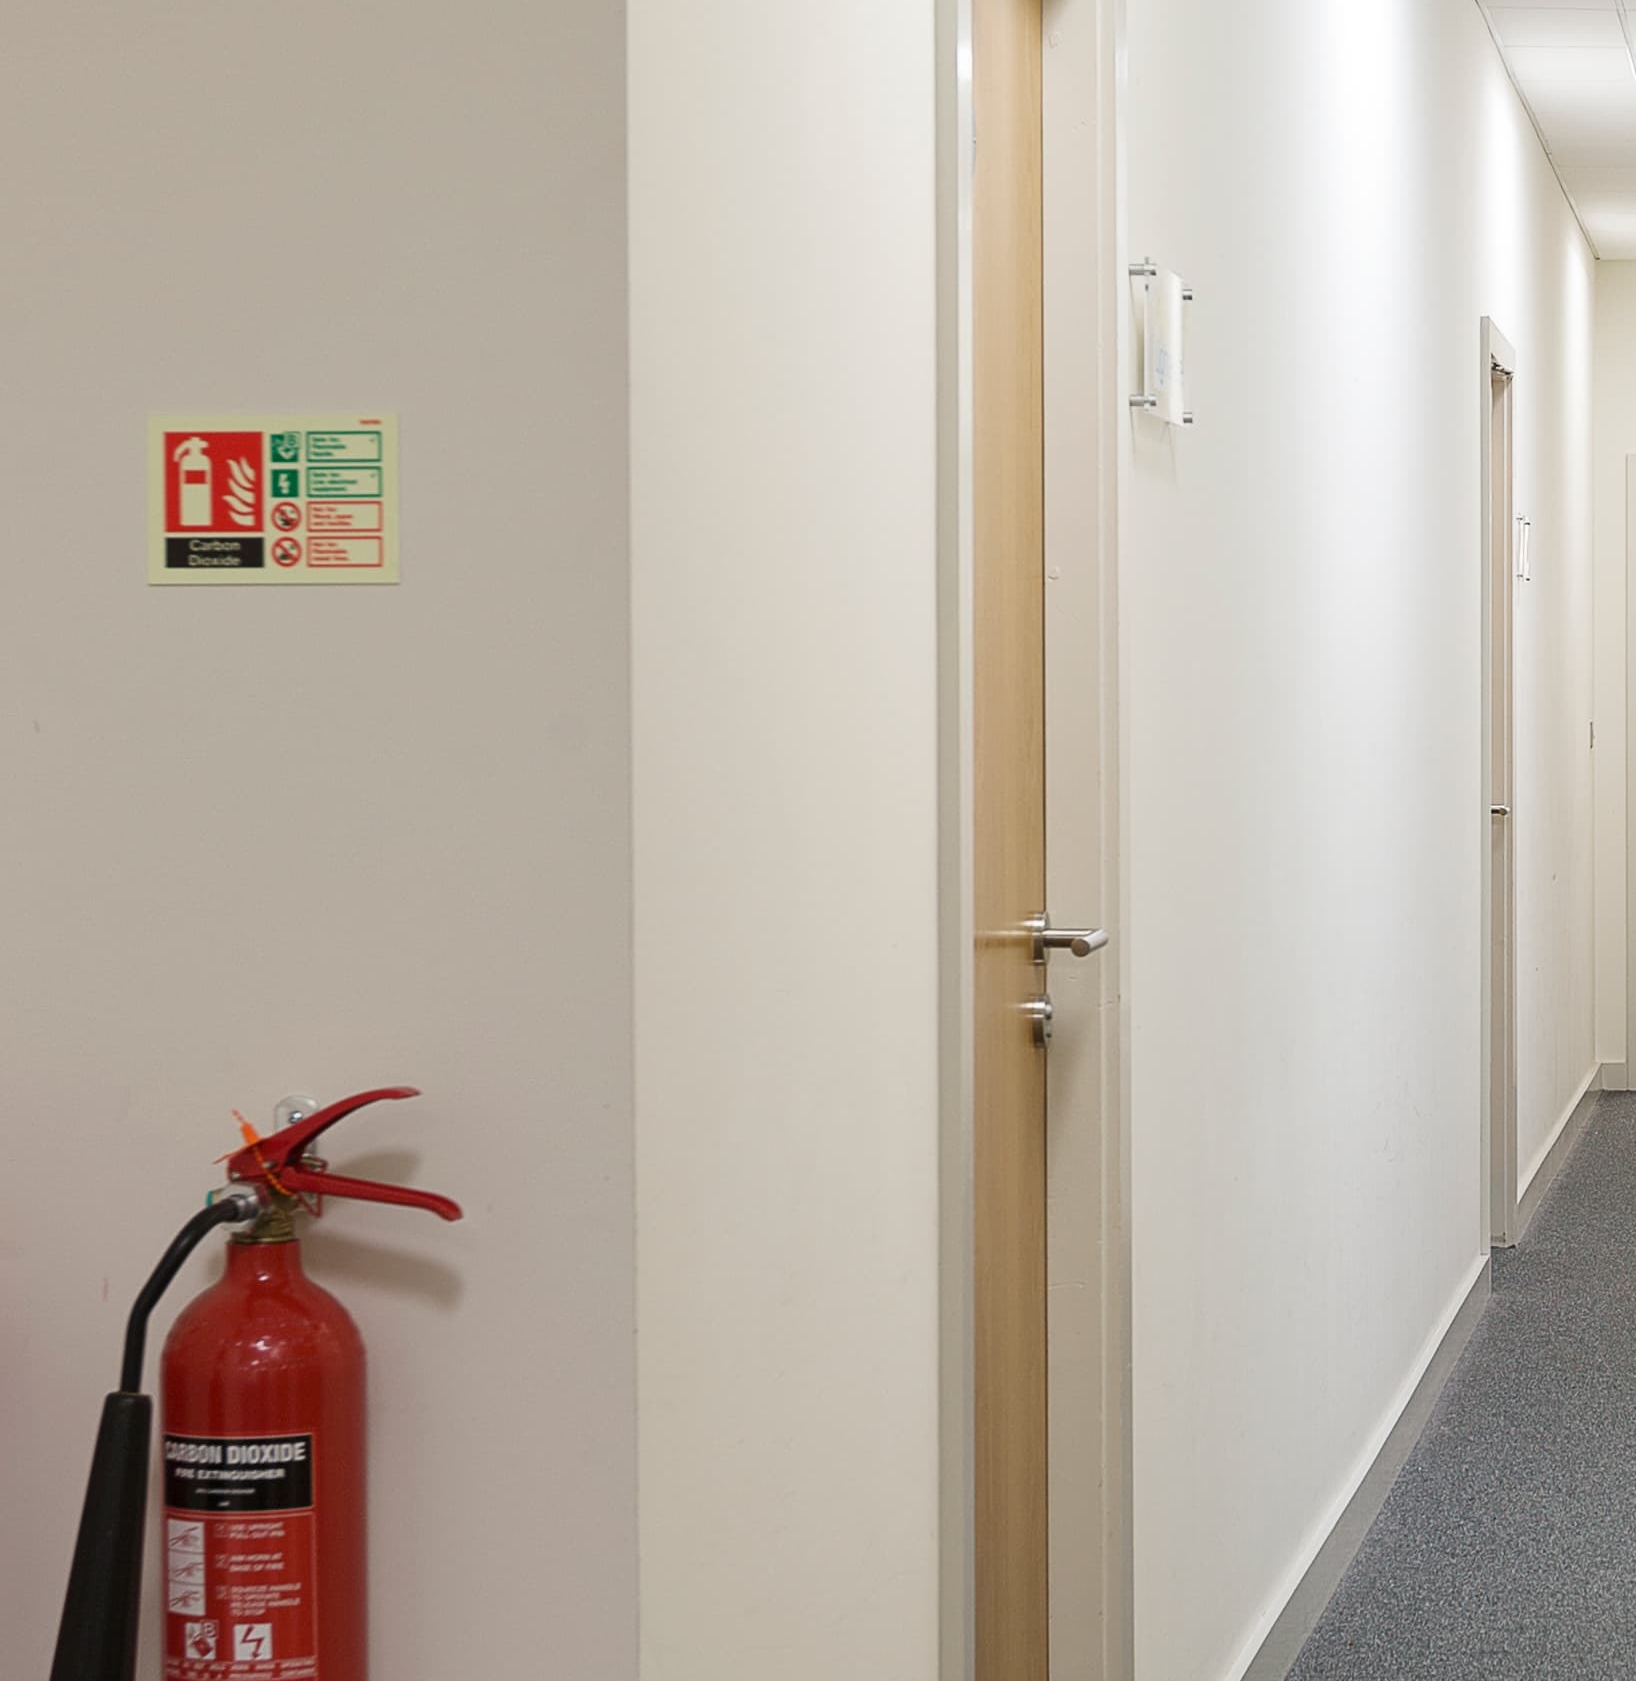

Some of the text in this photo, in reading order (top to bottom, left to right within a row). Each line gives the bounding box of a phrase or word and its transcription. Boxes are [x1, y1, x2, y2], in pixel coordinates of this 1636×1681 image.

[189, 540, 241, 551] Carbon
[188, 555, 241, 566] Dioxide
[165, 1441, 306, 1464] CARBON DIOXIDE
[175, 1469, 285, 1479] FIRE EXTINGUISHER
